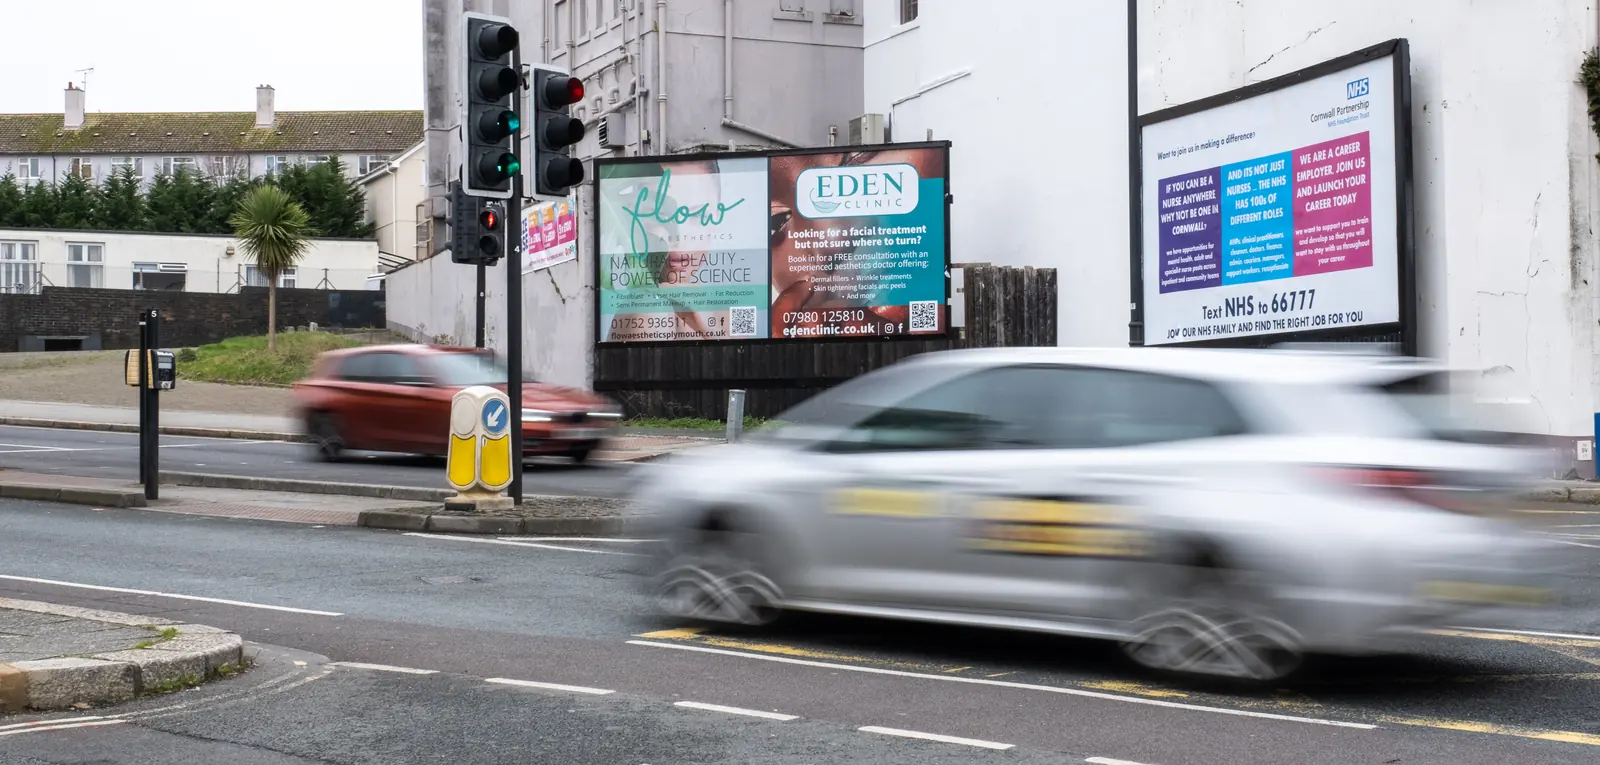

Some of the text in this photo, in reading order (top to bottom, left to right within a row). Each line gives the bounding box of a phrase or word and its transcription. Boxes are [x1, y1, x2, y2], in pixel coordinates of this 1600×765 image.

[1348, 79, 1368, 98] NHS
[1311, 100, 1370, 122] Cornwall Partnership
[1337, 116, 1359, 124] Foundation
[1157, 152, 1170, 160] Want
[1177, 148, 1186, 157] join
[1201, 139, 1220, 150] making
[1300, 142, 1360, 165] WE ARE A CAREER
[1228, 159, 1285, 180] AND ITS NOT JUST
[1336, 160, 1353, 173] JOIN
[1355, 157, 1365, 168] US
[816, 172, 905, 198] EDEN
[1166, 175, 1213, 194] IF YOU CAN BE A
[1227, 175, 1286, 196] NURSES THE NHS
[1297, 174, 1366, 198] AND LAUNCH YOUR
[844, 198, 902, 209] CLINIC
[1163, 190, 1216, 209] NURSE ANYWHERE
[1236, 192, 1277, 209] HAS 100s OF
[1306, 192, 1357, 212] CAREER TODAY
[622, 168, 745, 261] flow
[1161, 204, 1219, 223] WHY NOT BE ONE IN
[1230, 207, 1284, 226] DIFFERENT ROLES
[788, 229, 825, 239] Looking
[827, 228, 840, 237] for
[850, 226, 876, 236] facial
[877, 225, 926, 235] treatment
[1172, 222, 1207, 235] CORNWALL?
[1322, 222, 1340, 231] support
[1341, 222, 1350, 230] you
[1357, 216, 1368, 224] train
[795, 240, 811, 249] but
[813, 240, 828, 248] not
[852, 238, 882, 247] where
[896, 236, 922, 244] turn?
[1299, 237, 1308, 245] and
[1309, 235, 1328, 243] develop
[1346, 232, 1355, 240] you
[1356, 227, 1365, 235] will
[1325, 244, 1336, 252] with
[1343, 239, 1370, 250] throughout
[610, 252, 736, 270] NATURAL BEAUTY
[854, 252, 899, 260] consultation
[1318, 258, 1329, 266] your
[789, 263, 832, 273] experienced
[898, 260, 929, 268] offering:
[610, 268, 751, 286] POWER OF SCIENCE
[827, 284, 857, 292] tightening
[1202, 289, 1315, 320] Text NHS to 66777
[612, 317, 686, 329] 01752 936511
[783, 310, 864, 323] 07980 125810
[1182, 327, 1196, 337] OUR
[1198, 325, 1211, 336] NHS
[1213, 323, 1236, 334] FAMILY
[1238, 322, 1253, 332] AND
[1255, 321, 1271, 331] FIND
[1273, 319, 1285, 329] THE
[1288, 316, 1309, 328] RIGHT
[1312, 315, 1326, 326] JOB
[1328, 313, 1343, 324] FOR
[1346, 311, 1363, 322] YOU
[612, 330, 726, 339] flowaestheticsplymouth.co.uk
[783, 323, 875, 336] edenclinic.co.uk
